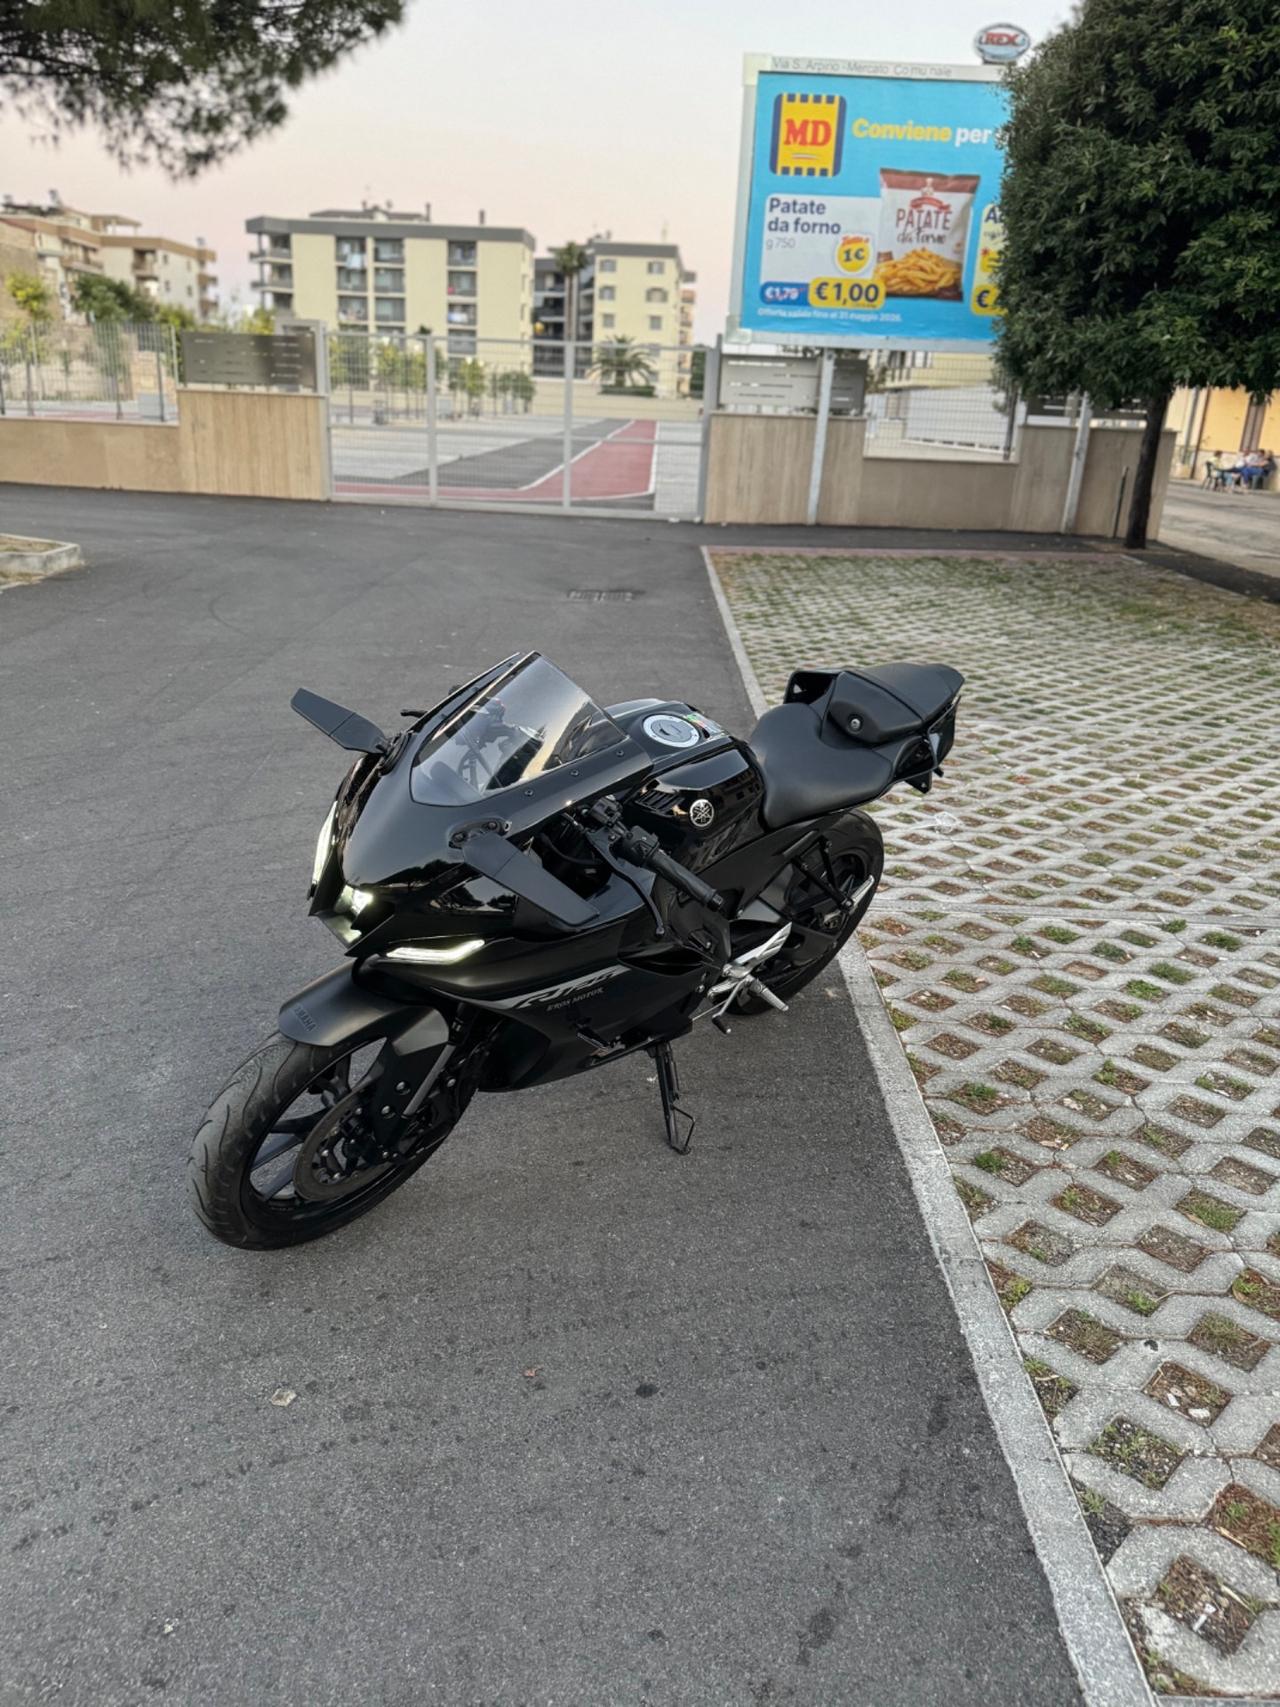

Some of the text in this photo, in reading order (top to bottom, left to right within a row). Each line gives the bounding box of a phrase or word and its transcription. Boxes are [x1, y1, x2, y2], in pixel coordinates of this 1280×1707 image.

[772, 57, 790, 68] Via
[805, 59, 840, 73] Arpino
[847, 62, 890, 75] Mercato
[783, 118, 832, 147] MD
[852, 118, 952, 142] Conviene
[954, 126, 993, 147] per
[768, 197, 827, 215] Patate
[767, 216, 842, 234] da forno
[895, 208, 953, 230] PATATE
